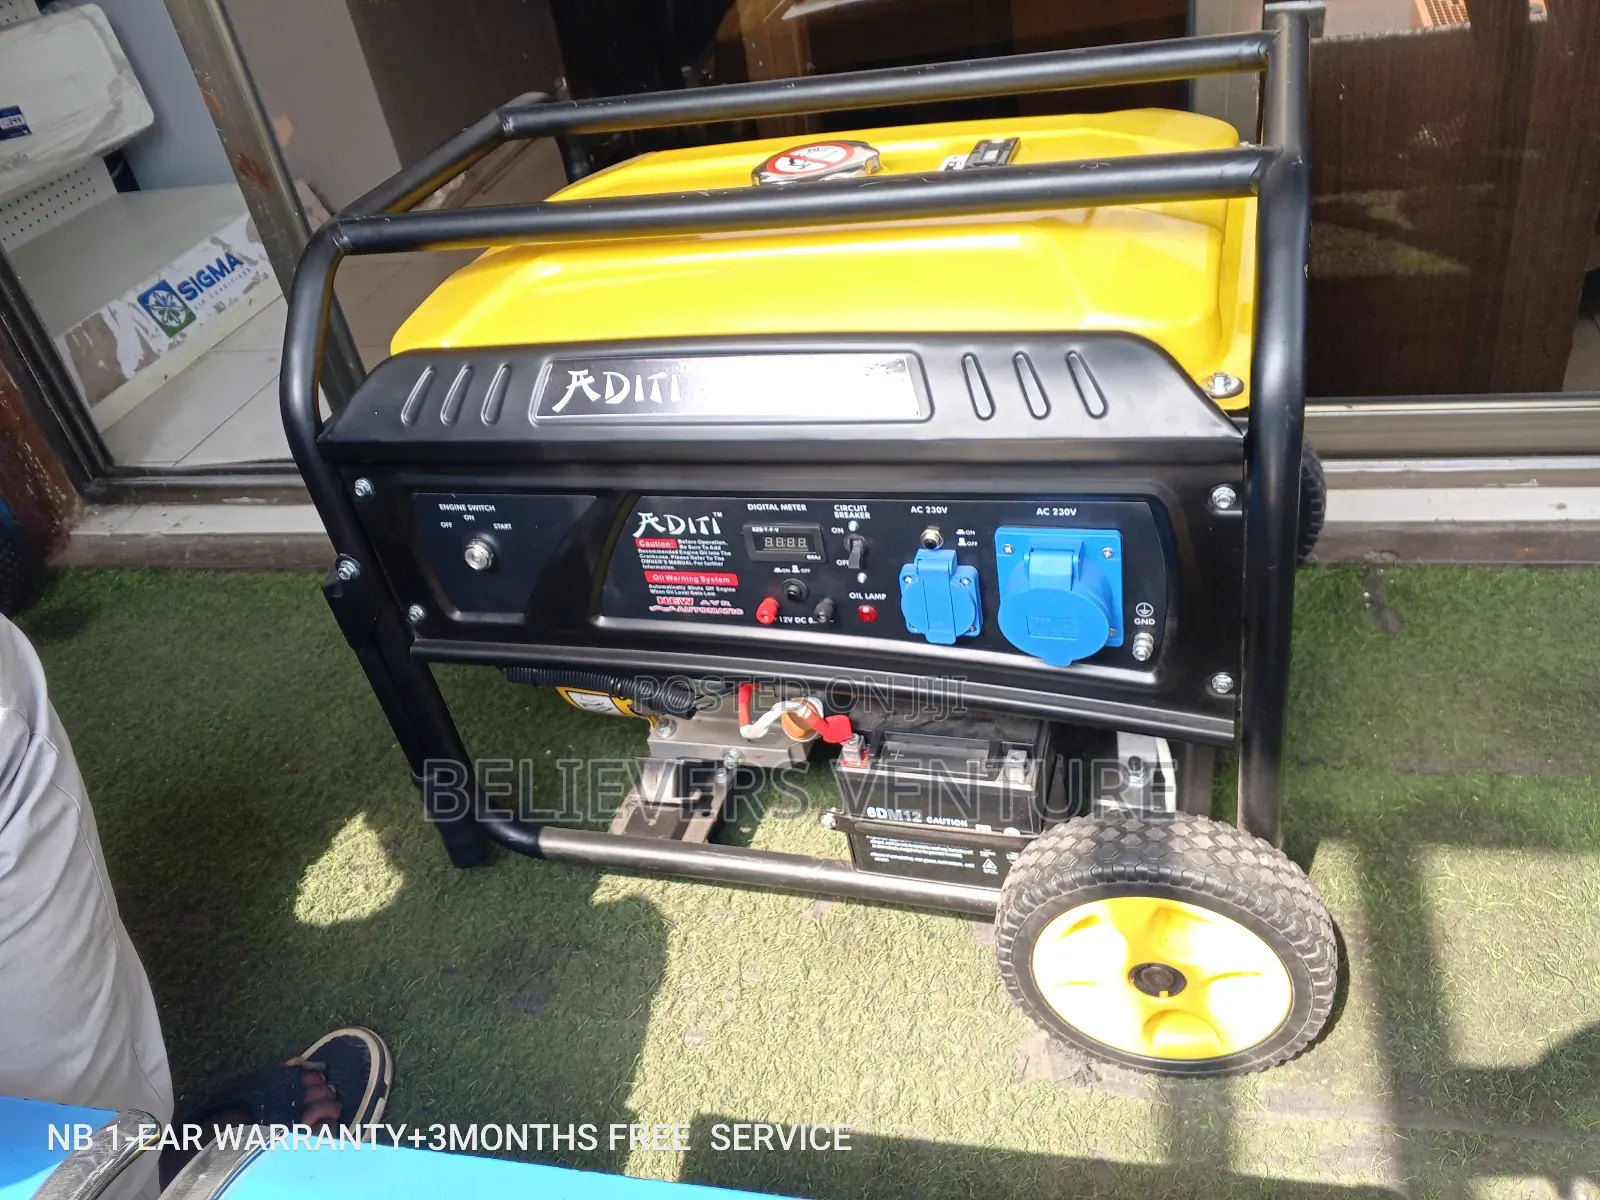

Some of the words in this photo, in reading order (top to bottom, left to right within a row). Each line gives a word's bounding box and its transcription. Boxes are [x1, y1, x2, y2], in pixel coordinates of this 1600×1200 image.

[177, 251, 244, 301] SIGMA
[551, 368, 684, 414] ADITI
[439, 503, 466, 511] ENGINE
[467, 504, 496, 512] SWITCH
[747, 503, 780, 512] DIGITAL
[780, 503, 807, 512] METER
[833, 504, 868, 512] CIRCUIT
[910, 505, 924, 514] AC
[925, 505, 948, 515] 230V
[1036, 507, 1051, 517] AC
[1052, 507, 1077, 517] 230V
[833, 511, 871, 519] BREAKER
[440, 521, 453, 529] OFF
[632, 511, 721, 538] ADITI
[638, 540, 675, 548] Caution:
[652, 573, 664, 581] Oil
[665, 574, 700, 583] Warning
[700, 575, 731, 584] System
[849, 592, 863, 600] OIL
[864, 592, 887, 601] LAMP
[656, 596, 694, 606] NEW
[700, 599, 732, 607] AVR
[779, 616, 793, 624] 12V
[794, 616, 807, 624] DC
[1134, 617, 1156, 626] GND
[866, 806, 922, 823] 6DM12
[926, 815, 968, 827] CAUTION
